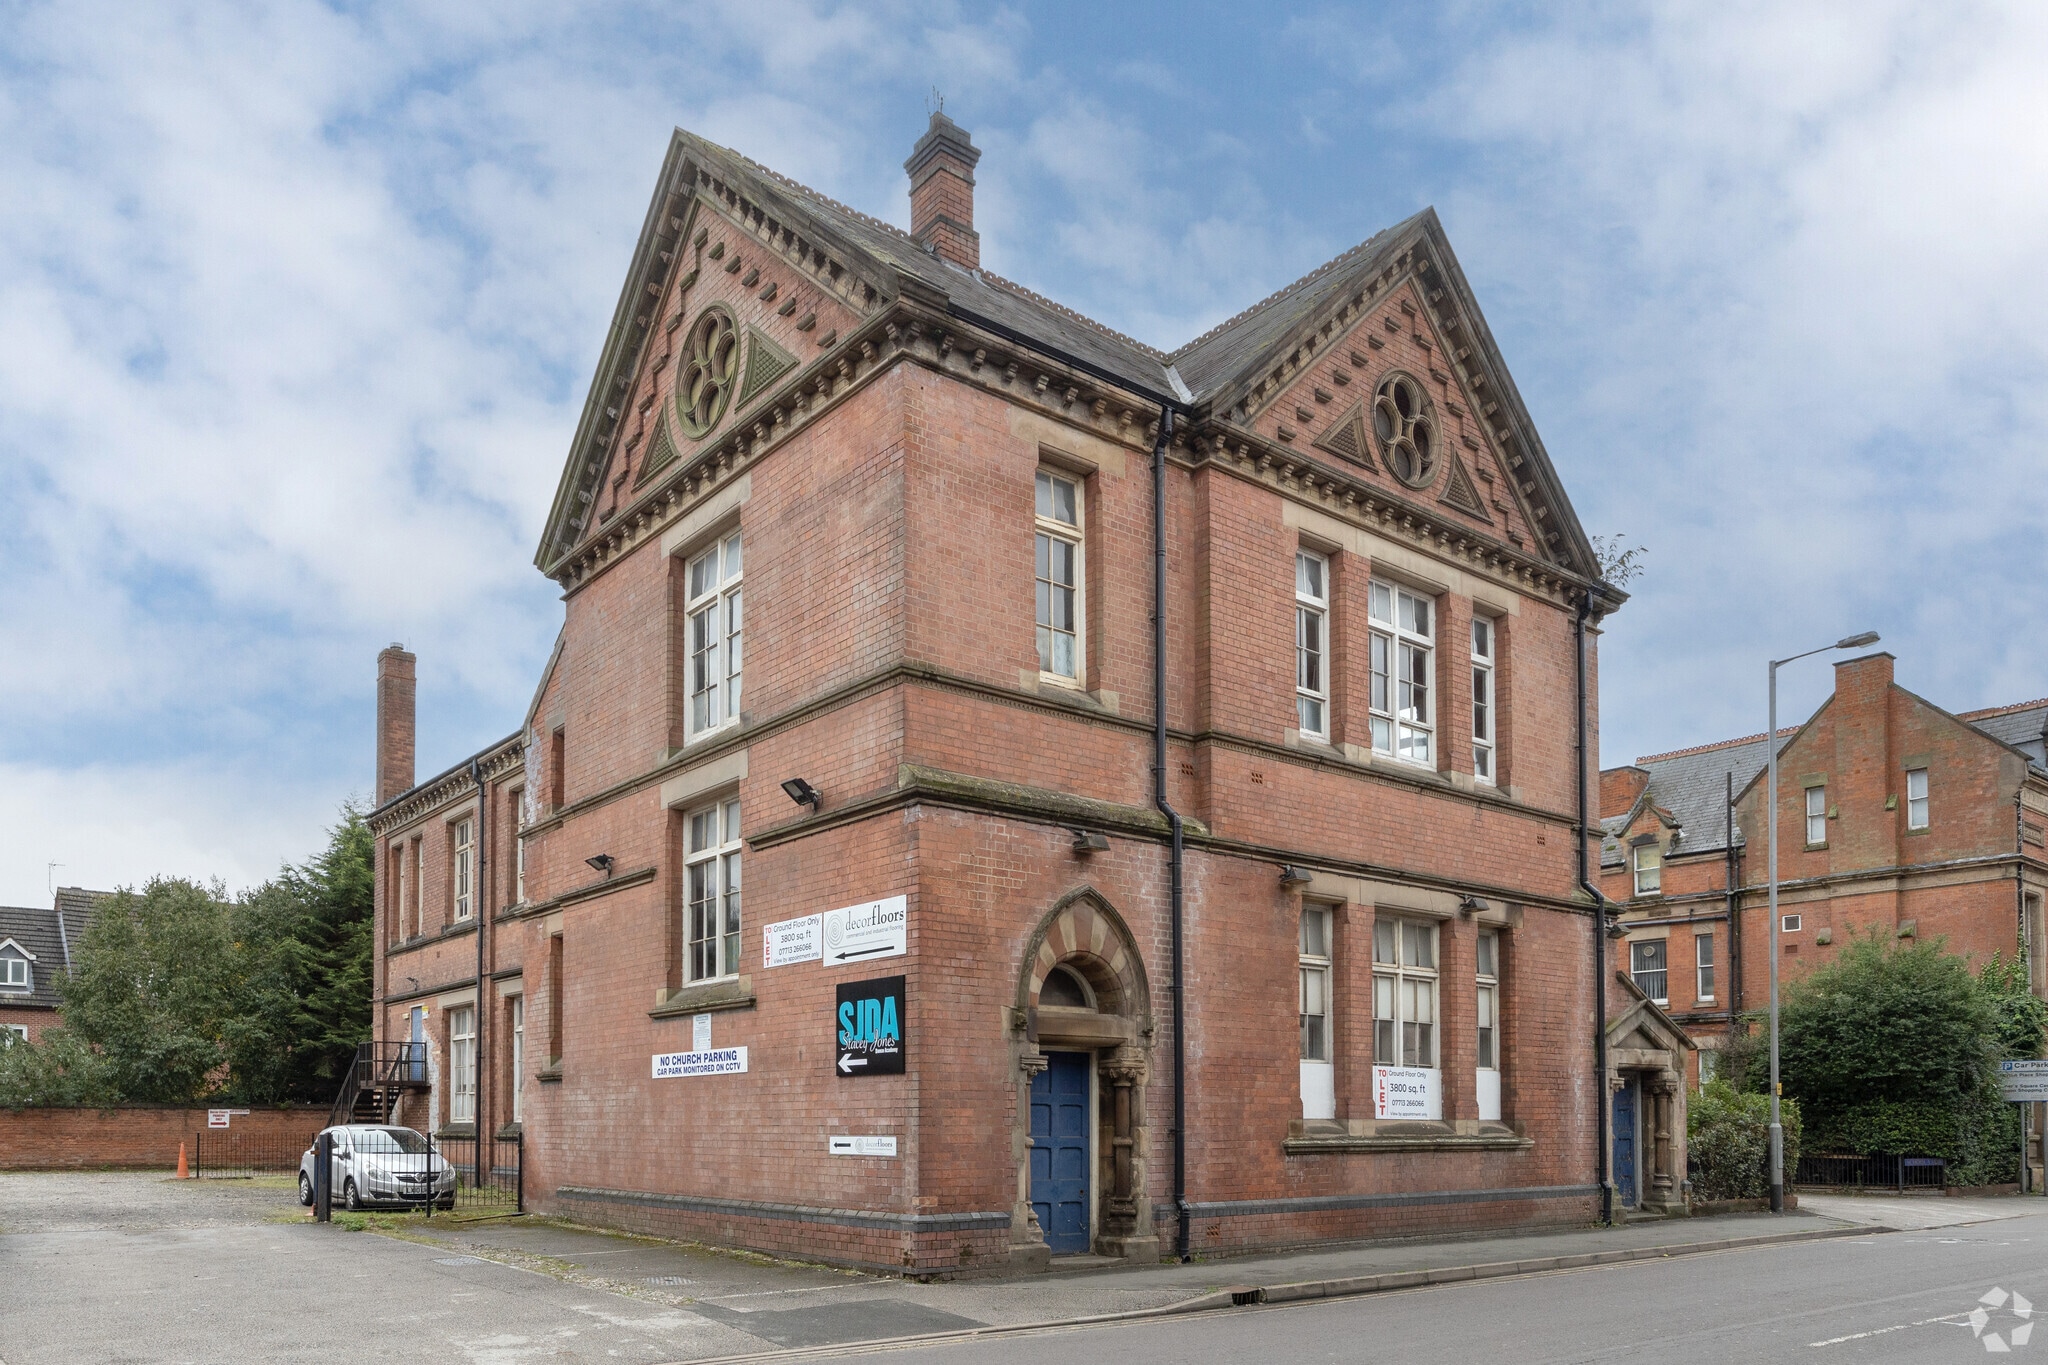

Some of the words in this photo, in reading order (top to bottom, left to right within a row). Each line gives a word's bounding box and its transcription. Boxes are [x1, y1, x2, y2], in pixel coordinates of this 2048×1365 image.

[773, 922, 792, 933] Ground
[793, 920, 806, 929] Floor
[807, 916, 820, 926] Only
[846, 904, 904, 931] decorfloors
[781, 933, 796, 944] 3800
[839, 996, 899, 1046] SJDA
[841, 1031, 868, 1054] Stacey
[869, 1028, 896, 1052] Jones
[660, 1056, 670, 1067] NO
[671, 1053, 702, 1066] CHURCH
[703, 1050, 737, 1063] PARKING
[657, 1068, 668, 1076] CAR
[668, 1066, 683, 1075] PARK
[683, 1064, 715, 1074] MONITORED
[716, 1063, 725, 1071] ON
[725, 1062, 741, 1071] CCTV
[1378, 1069, 1387, 1077] TO
[1389, 1083, 1407, 1093] 3800
[1419, 1084, 1426, 1093] ft
[1392, 1099, 1406, 1107] 07713
